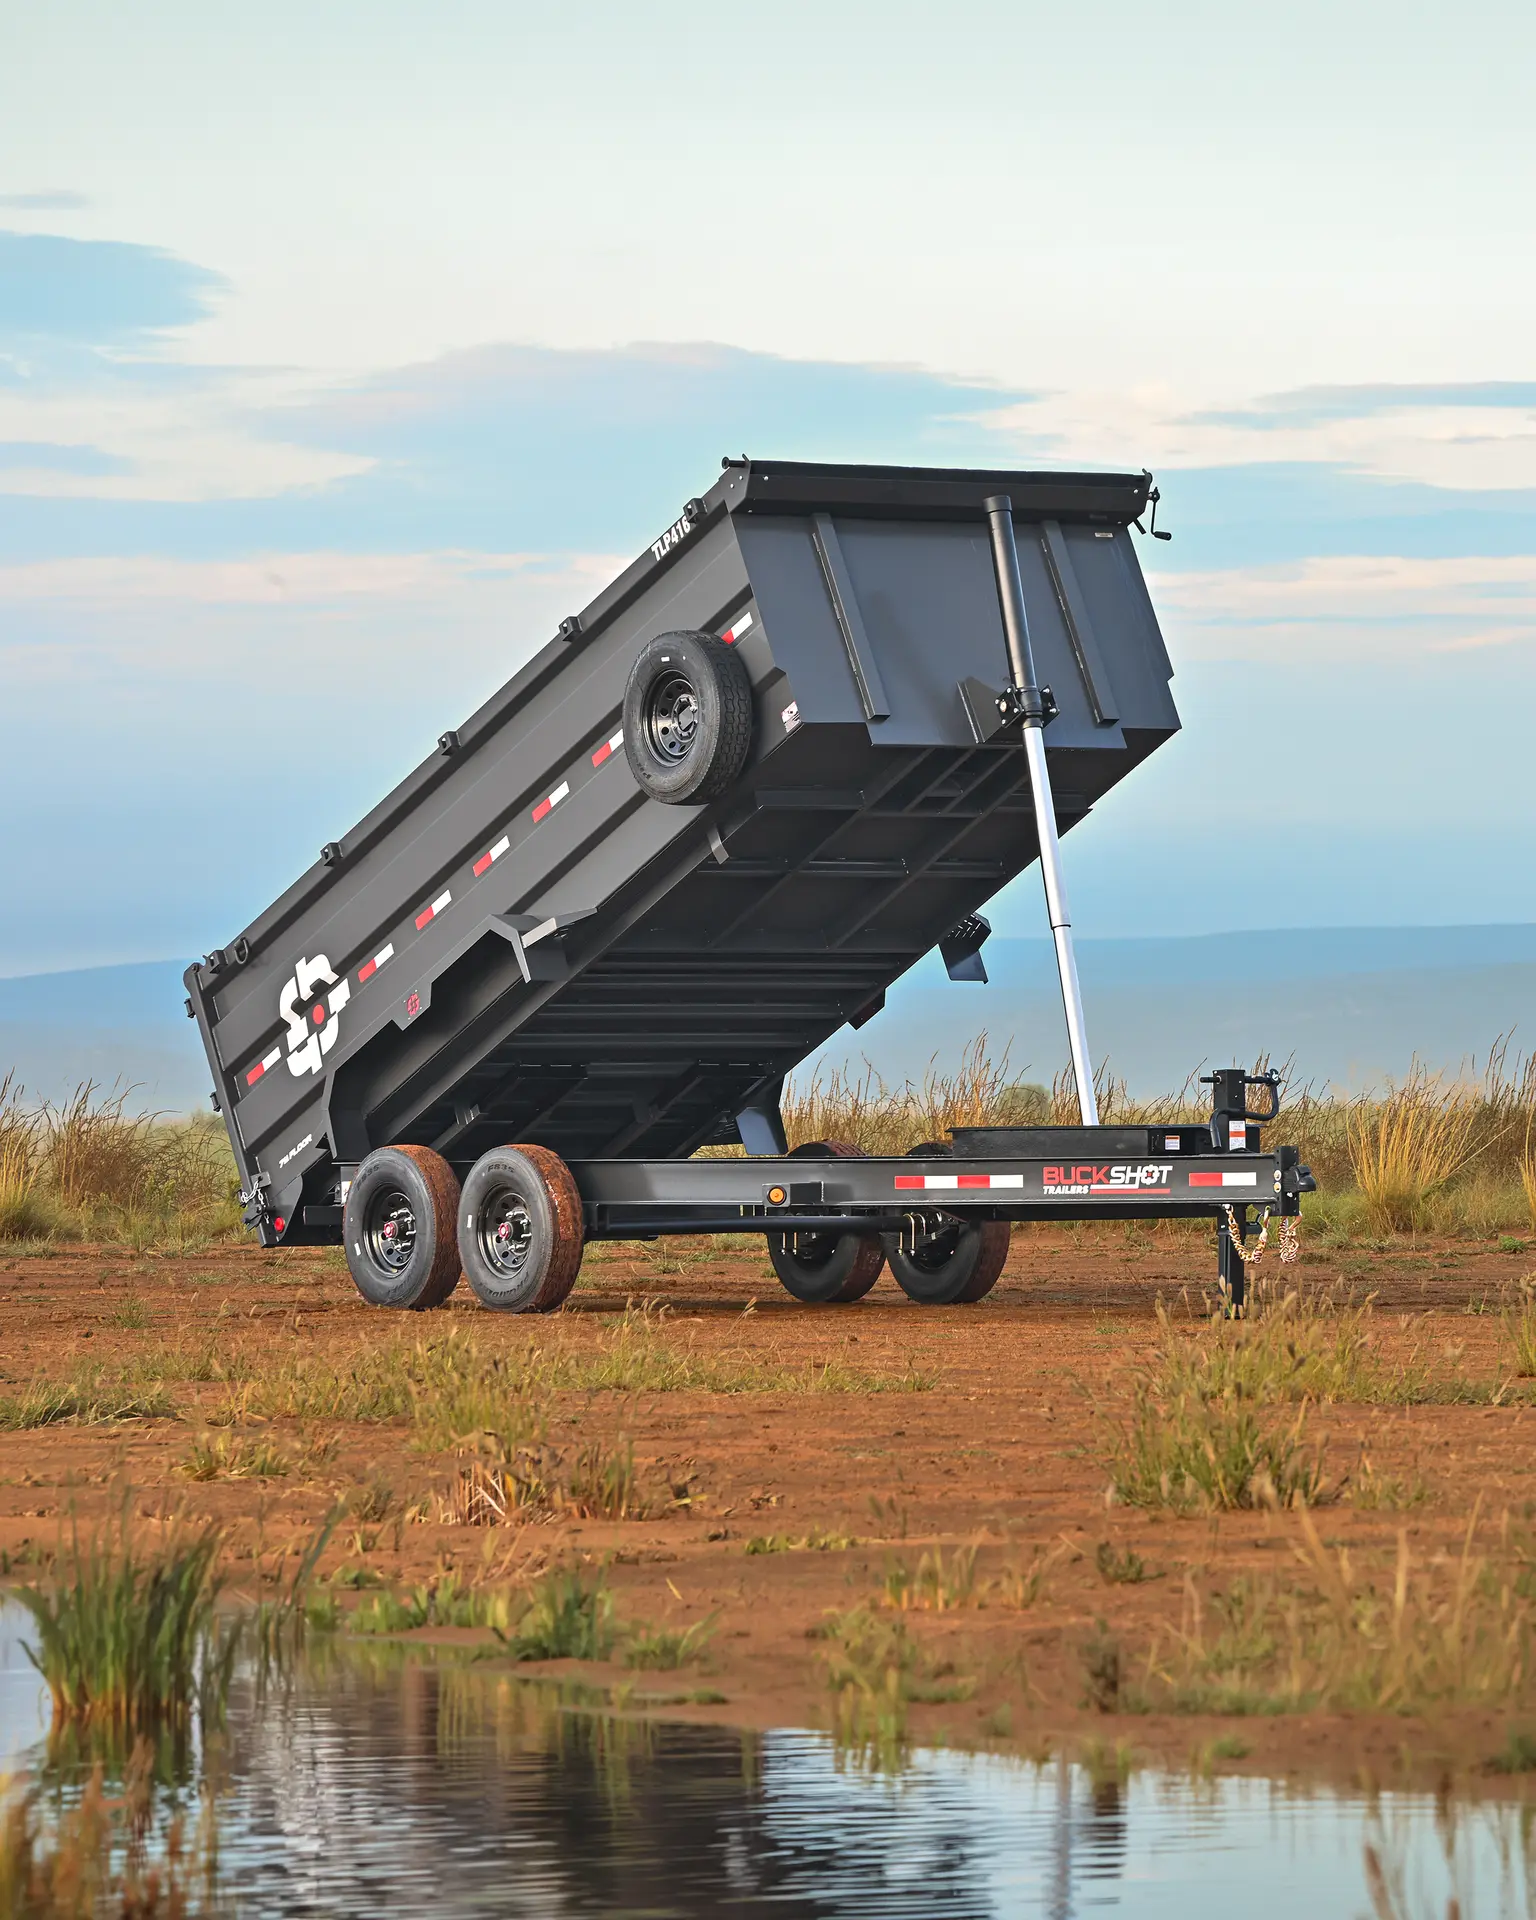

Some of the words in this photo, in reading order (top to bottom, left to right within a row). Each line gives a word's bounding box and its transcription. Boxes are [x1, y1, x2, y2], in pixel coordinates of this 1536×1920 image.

[650, 515, 691, 561] TLP416
[289, 1133, 313, 1160] FLOOR
[1042, 1164, 1173, 1188] BUCKSHOT
[1043, 1185, 1089, 1195] TRAILERS
